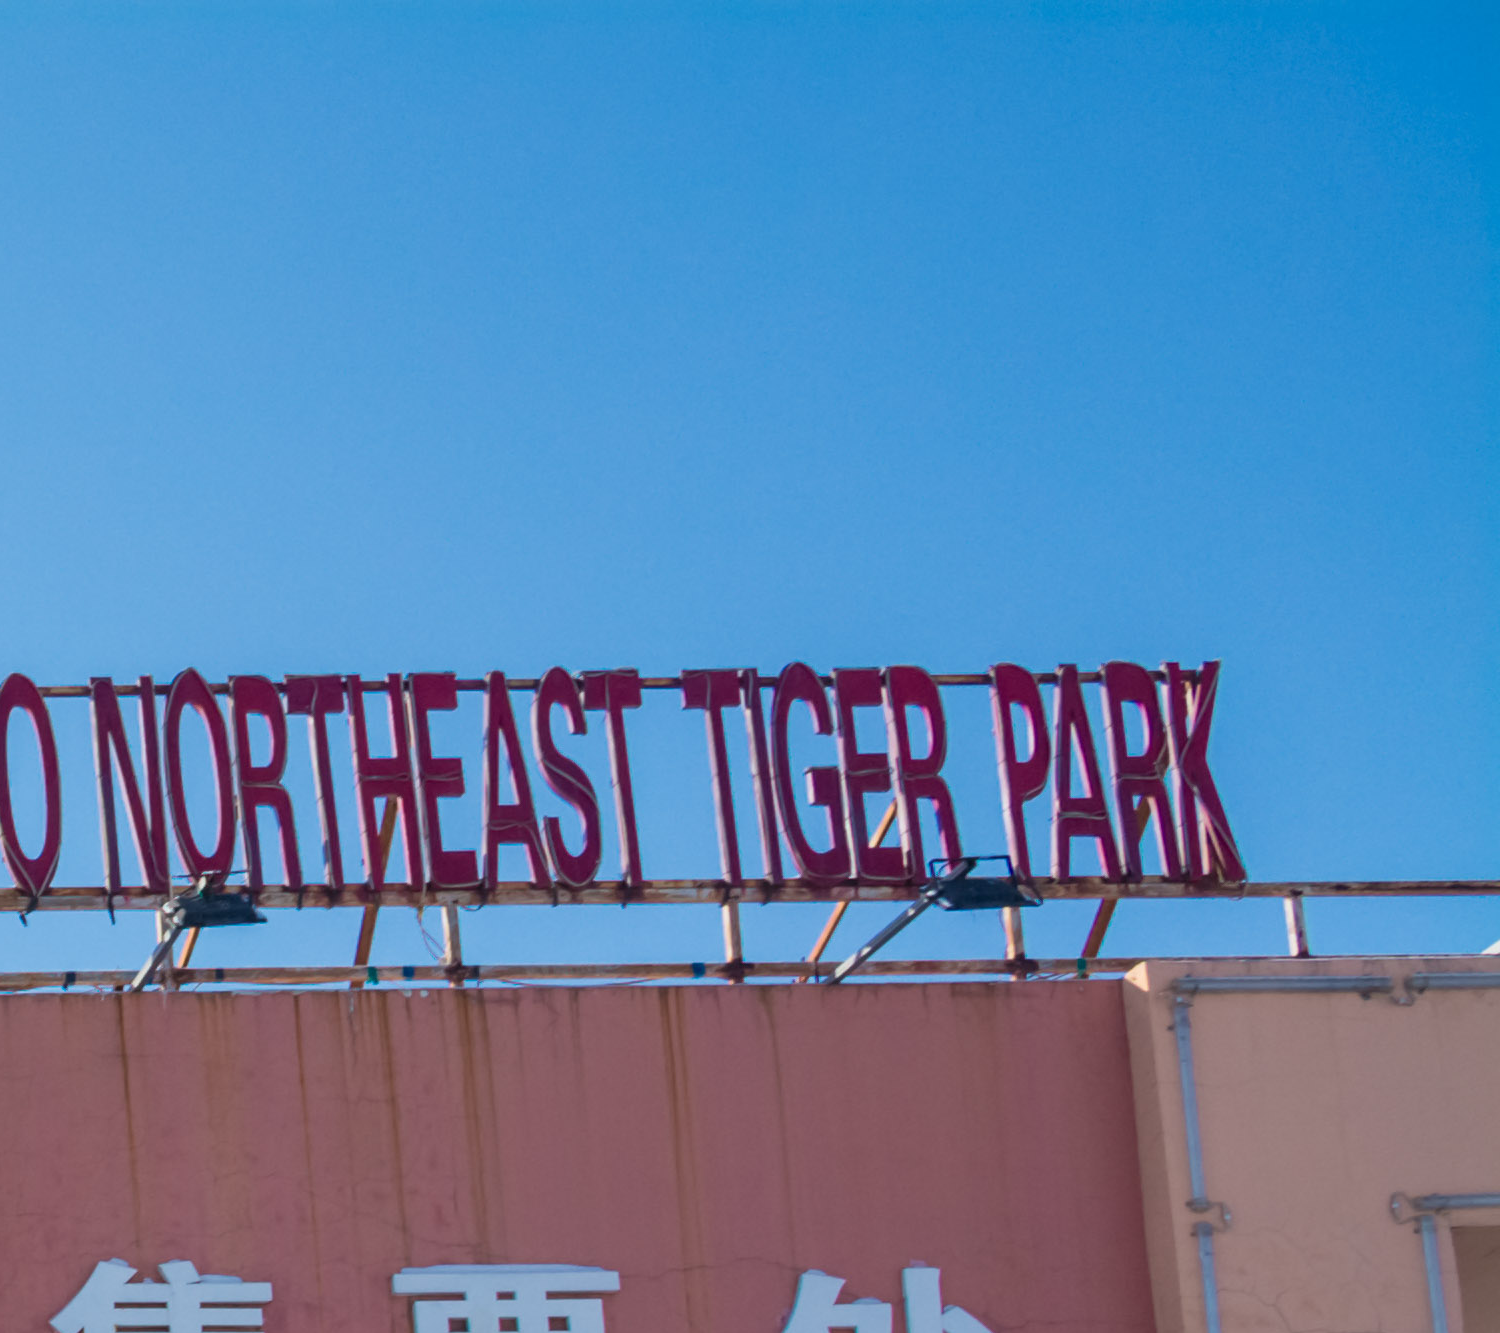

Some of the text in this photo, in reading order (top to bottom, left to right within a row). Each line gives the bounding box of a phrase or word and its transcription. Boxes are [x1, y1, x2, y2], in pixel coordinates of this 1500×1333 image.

[88, 668, 644, 891] NORTHEAST
[683, 661, 966, 886] TIGER
[988, 660, 1247, 886] PARK
